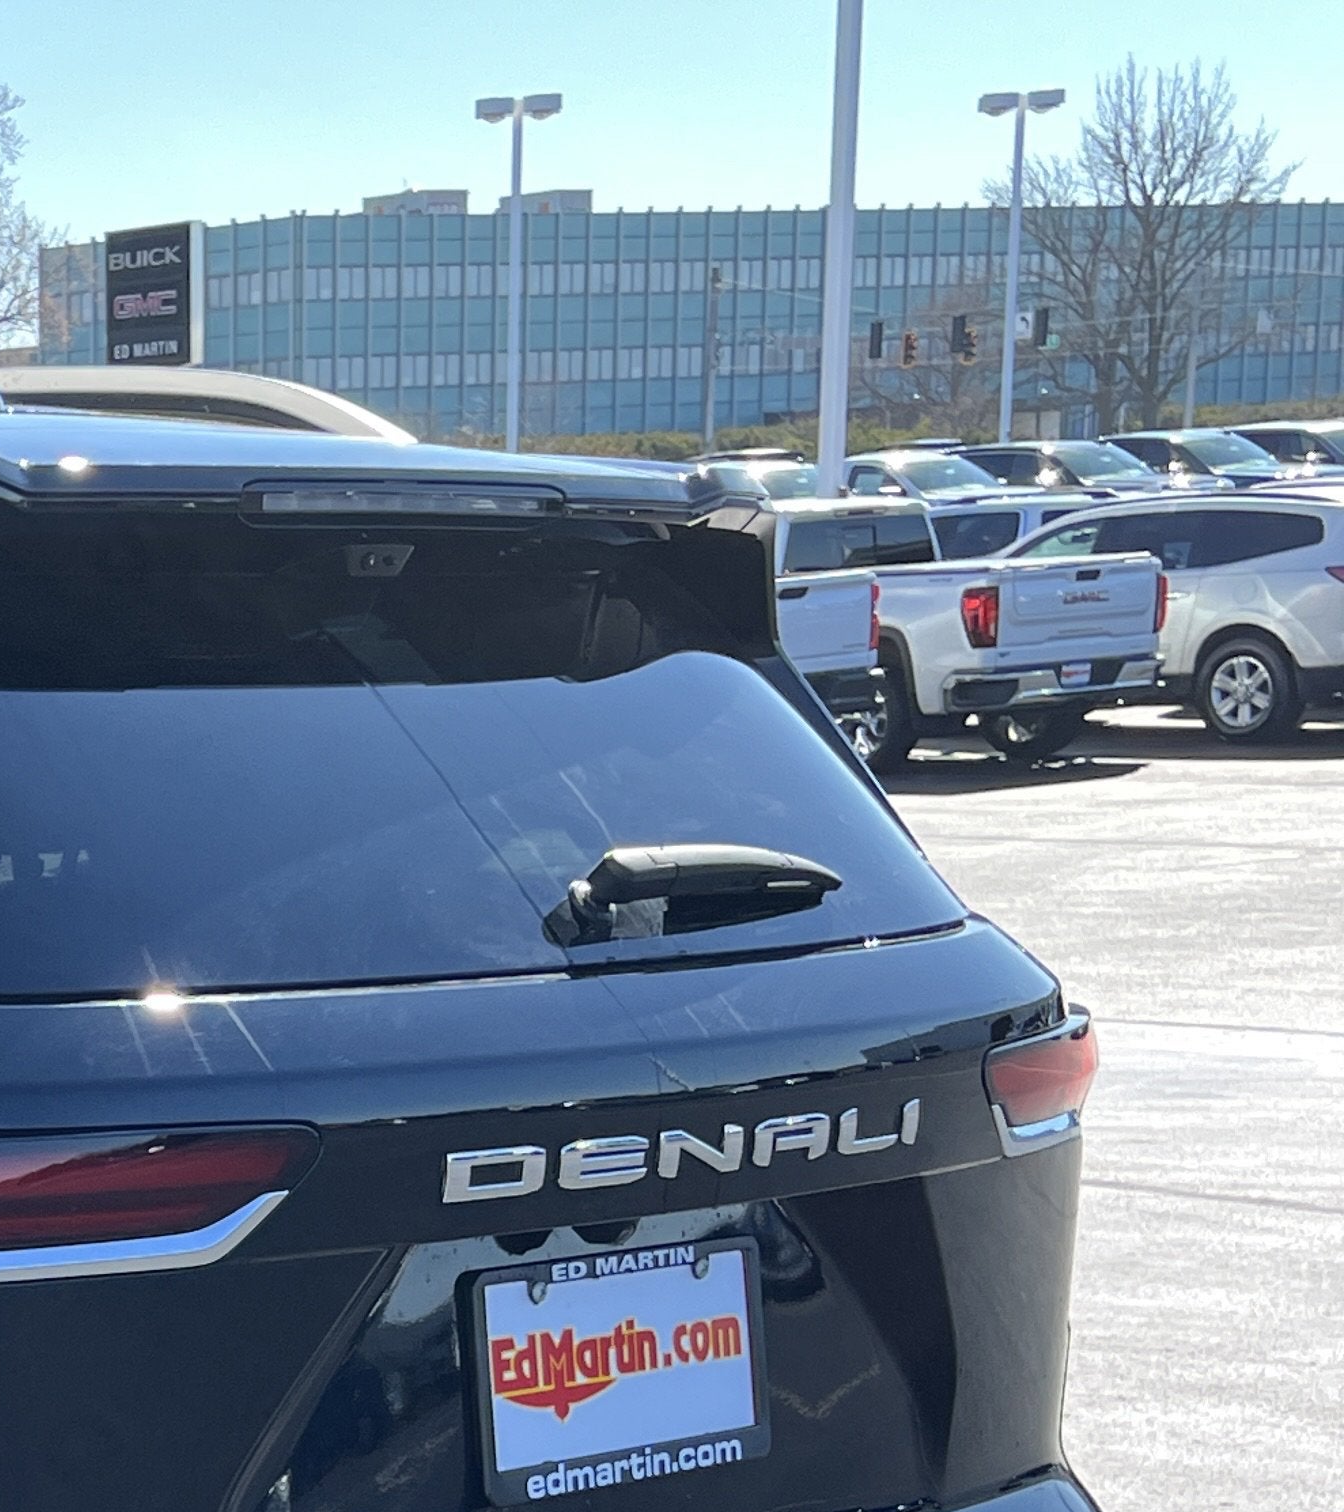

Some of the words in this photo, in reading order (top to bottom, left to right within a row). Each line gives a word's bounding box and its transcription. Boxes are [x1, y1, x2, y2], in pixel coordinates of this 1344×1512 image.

[108, 246, 181, 271] BUICK
[113, 290, 177, 320] GMC
[113, 344, 130, 361] ED
[133, 340, 178, 358] MARTIN
[442, 1099, 921, 1203] DENALI
[551, 1261, 587, 1282] ED
[594, 1246, 695, 1277] MARTIN
[526, 1438, 743, 1500] edmartin.com
